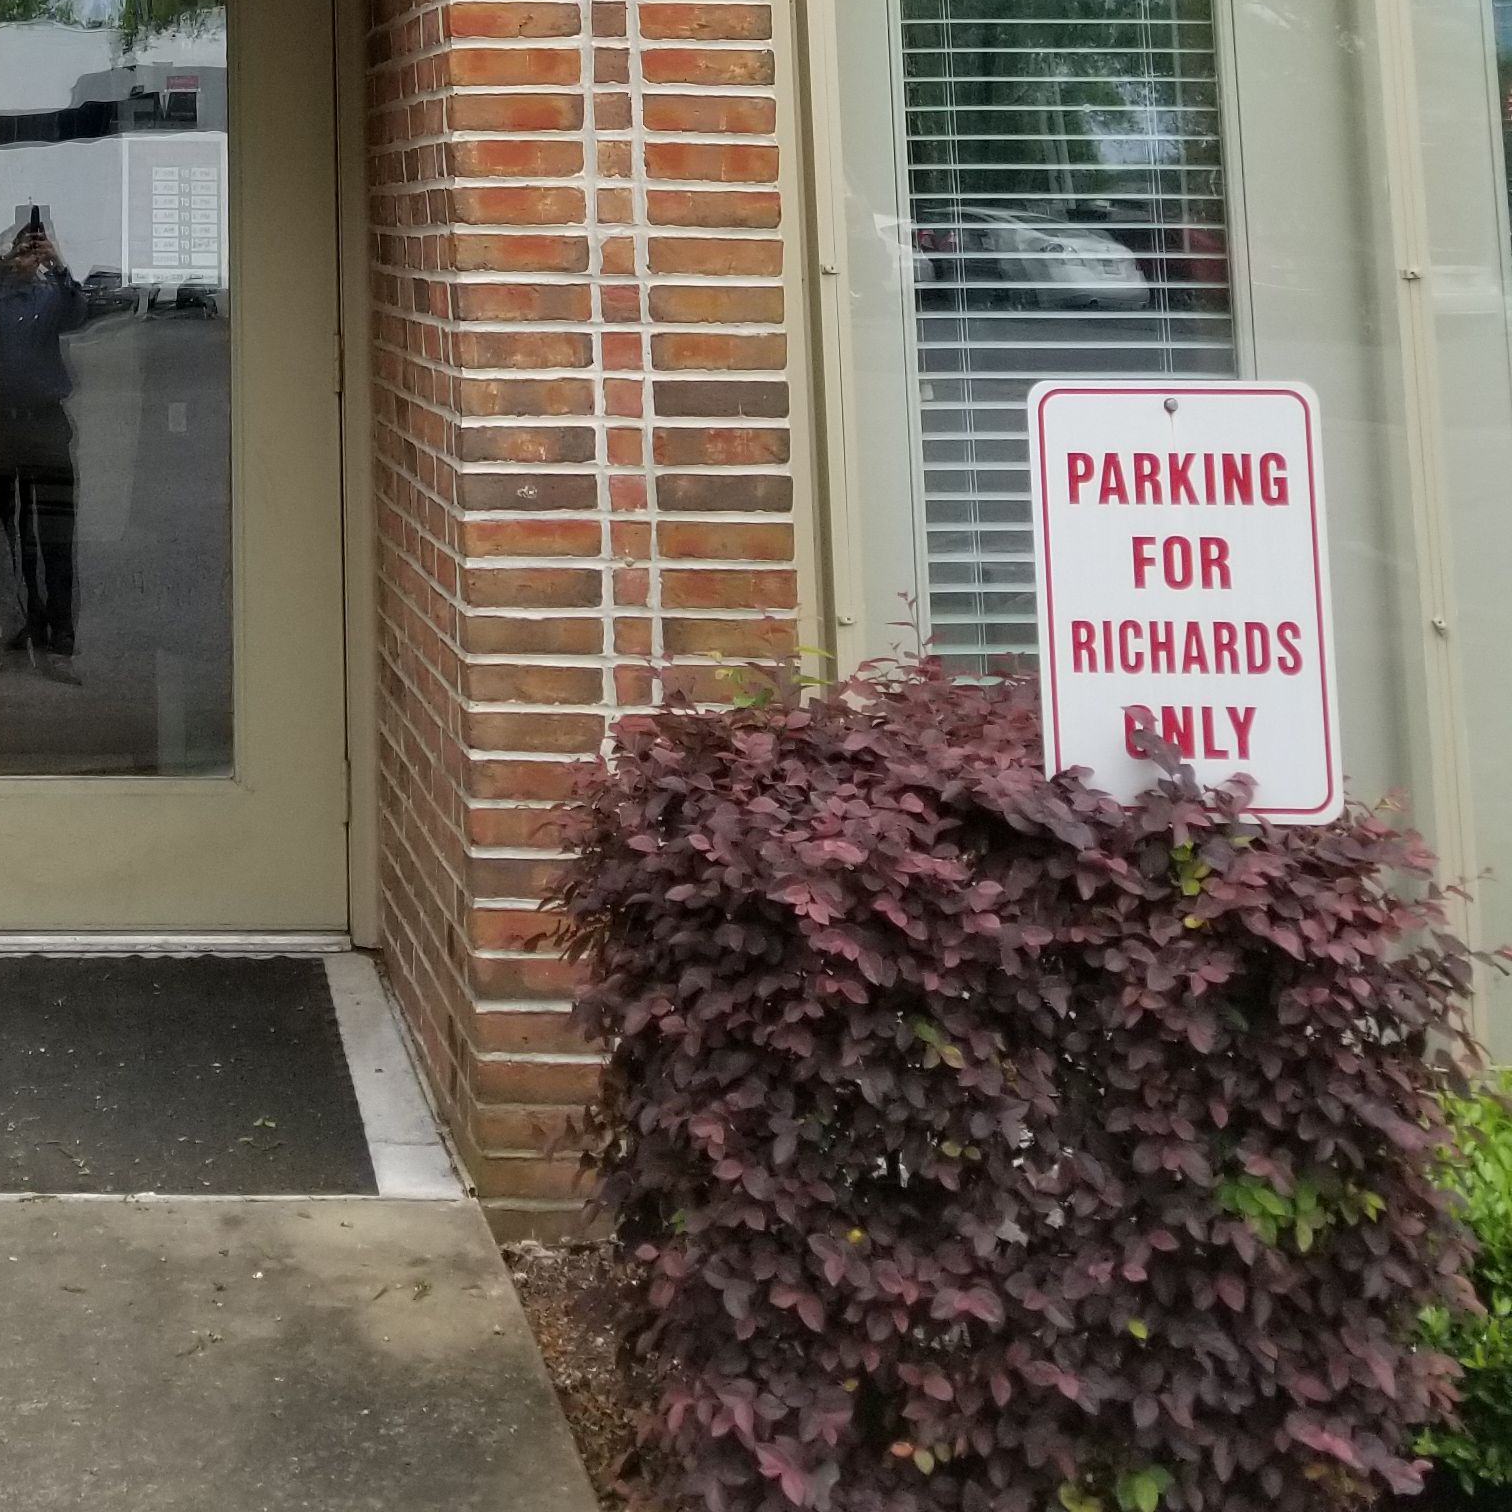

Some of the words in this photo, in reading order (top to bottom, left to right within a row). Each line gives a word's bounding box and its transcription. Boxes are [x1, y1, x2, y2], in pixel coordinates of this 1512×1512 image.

[1067, 452, 1288, 505] PARKING
[1132, 535, 1231, 589] FOR
[1071, 619, 1302, 675] RICHARDS
